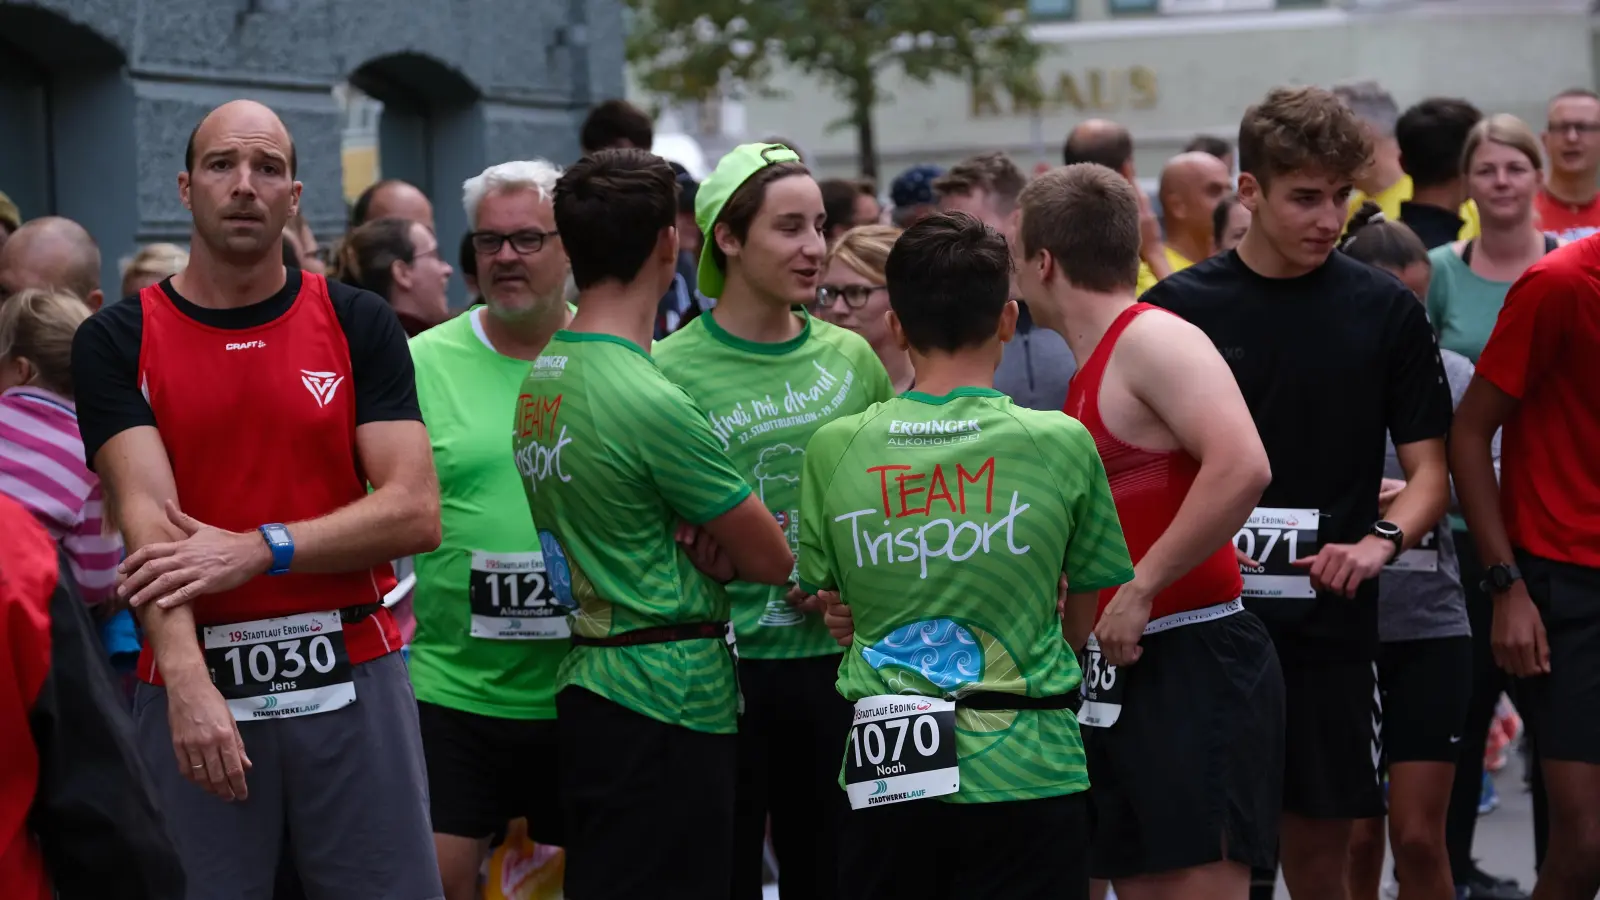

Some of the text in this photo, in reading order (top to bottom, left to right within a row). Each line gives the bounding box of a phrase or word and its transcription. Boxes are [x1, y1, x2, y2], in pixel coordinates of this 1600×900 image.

[226, 341, 258, 351] CRAFT
[519, 393, 563, 441] TEAM
[889, 418, 982, 435] ERDINGER
[887, 434, 980, 446] ALKOHOLFREI
[866, 456, 995, 518] TEAM
[834, 490, 1030, 579] Trisport
[1232, 528, 1298, 563] 071
[485, 573, 559, 607] 112
[500, 607, 554, 616] Alexander
[283, 624, 310, 636] ERDING
[225, 635, 336, 686] 1030
[269, 680, 297, 692] Jens
[253, 704, 320, 718] STADTWERKELAUF
[889, 703, 916, 714] ERDING
[851, 714, 940, 768] 1070
[876, 761, 906, 776] Noah
[868, 789, 926, 804] STADTWERKELAUF
